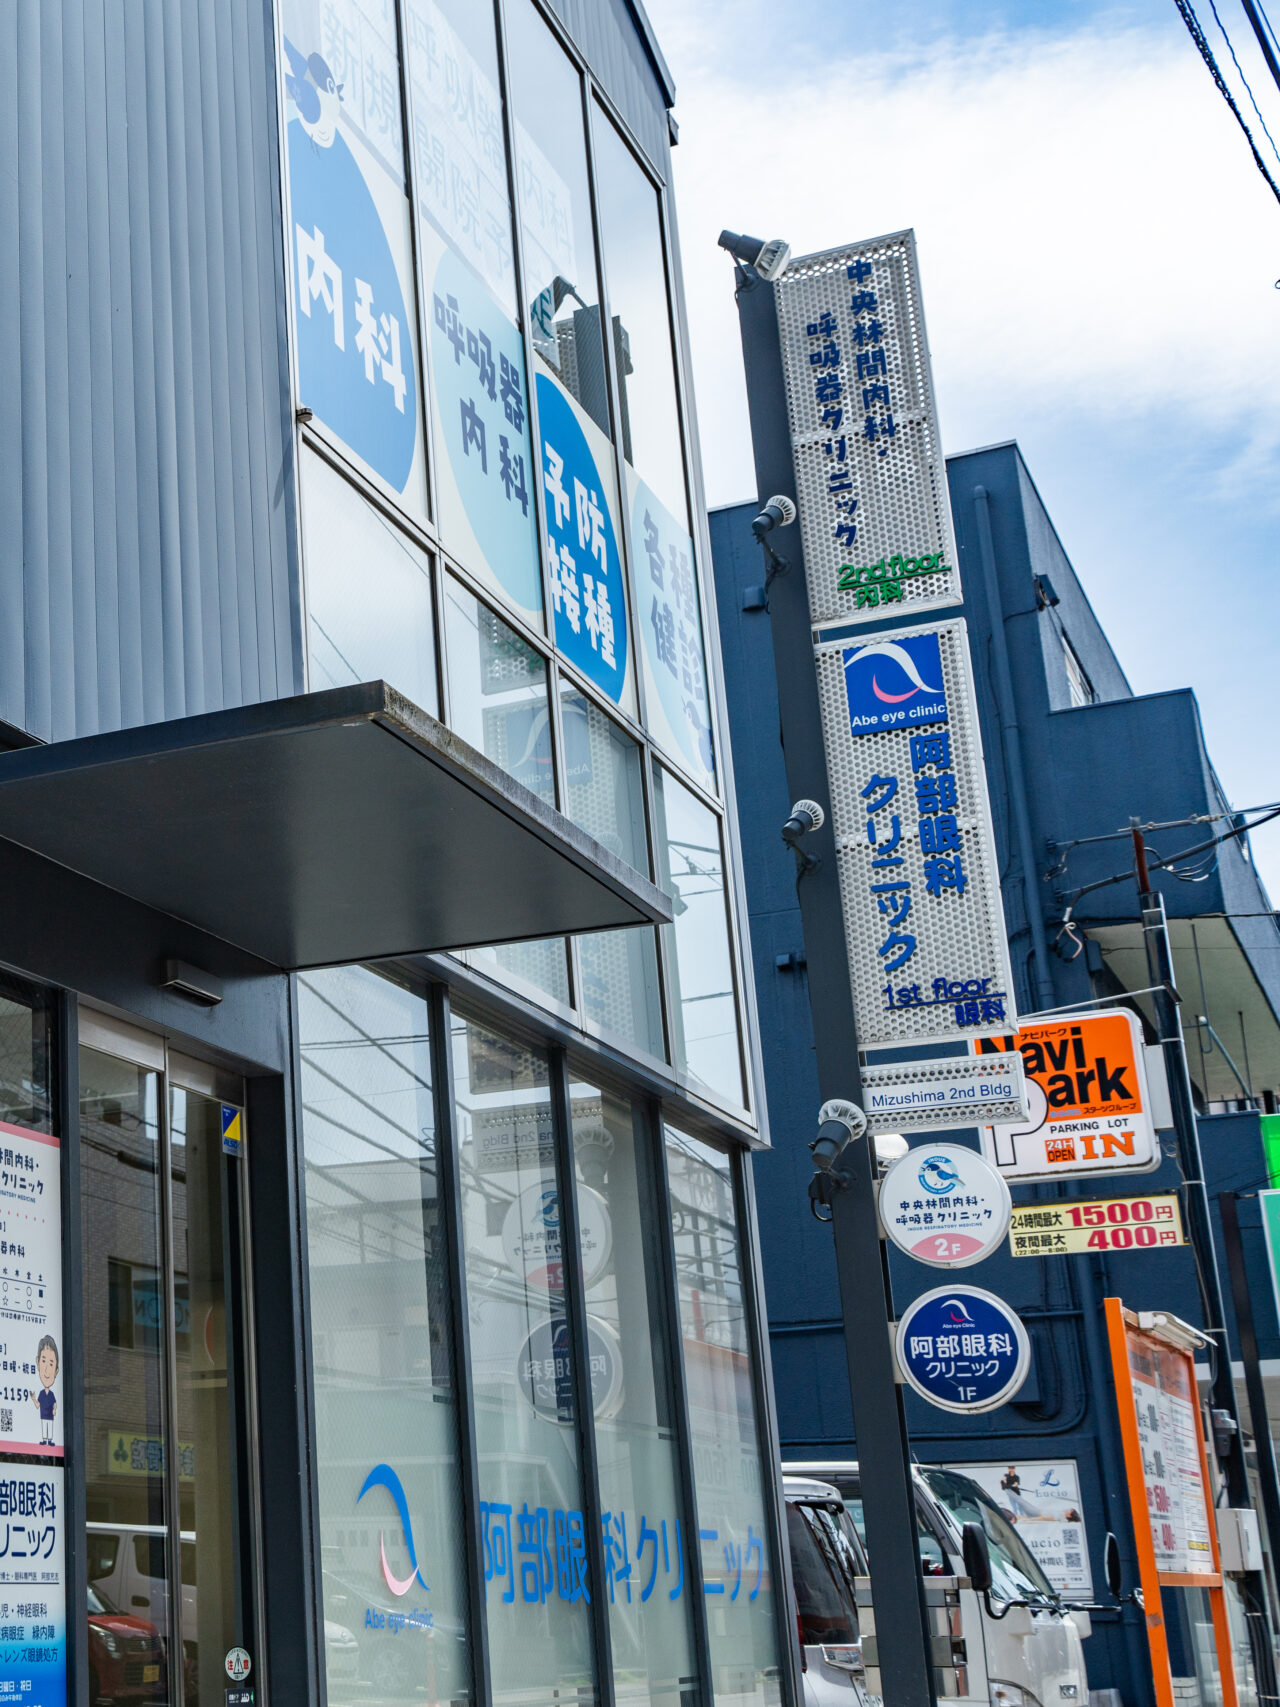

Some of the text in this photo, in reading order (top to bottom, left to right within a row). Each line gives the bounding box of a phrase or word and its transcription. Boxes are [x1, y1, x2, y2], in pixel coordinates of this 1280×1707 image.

[295, 223, 406, 415] 内科
[434, 294, 524, 434] 呼吸器
[806, 312, 858, 548] 呼吸器クリニック
[460, 398, 529, 517] 内科
[544, 440, 608, 576] 予防
[644, 508, 696, 627] 各種
[838, 551, 944, 586] 2nd floor
[548, 538, 616, 671] 接種
[857, 581, 903, 608] 内科
[651, 600, 705, 700] 健診
[852, 704, 946, 727] Abe eye clinic
[909, 732, 968, 896] 阿部眼科
[861, 774, 916, 972] クリニック
[882, 977, 991, 1007] 1st floor
[955, 999, 1006, 1027] 眼科
[1021, 1028, 1067, 1041] ナビパーク
[872, 1083, 1011, 1107] Mizushima 2nd Bldg
[1050, 1118, 1129, 1134] PARKING LOT
[1046, 1131, 1135, 1160] 24H IN
[1047, 1150, 1076, 1162] OPEN
[895, 1209, 992, 1226] 呼吸器クリニック
[1011, 1201, 1173, 1229] 24時間最大 1500円
[934, 1238, 961, 1257] 2F
[1015, 1226, 1177, 1250] 夜間最大 400円
[910, 1333, 1013, 1359] 阿部眼科
[926, 1360, 1000, 1378] クリニック
[957, 1387, 977, 1401] 1F
[1035, 1489, 1068, 1498] Lucio
[480, 1501, 764, 1604] 阿部眼科クリニック
[32, 1624, 56, 1641] 緑内障
[364, 1608, 434, 1634] Abe eye clinic
